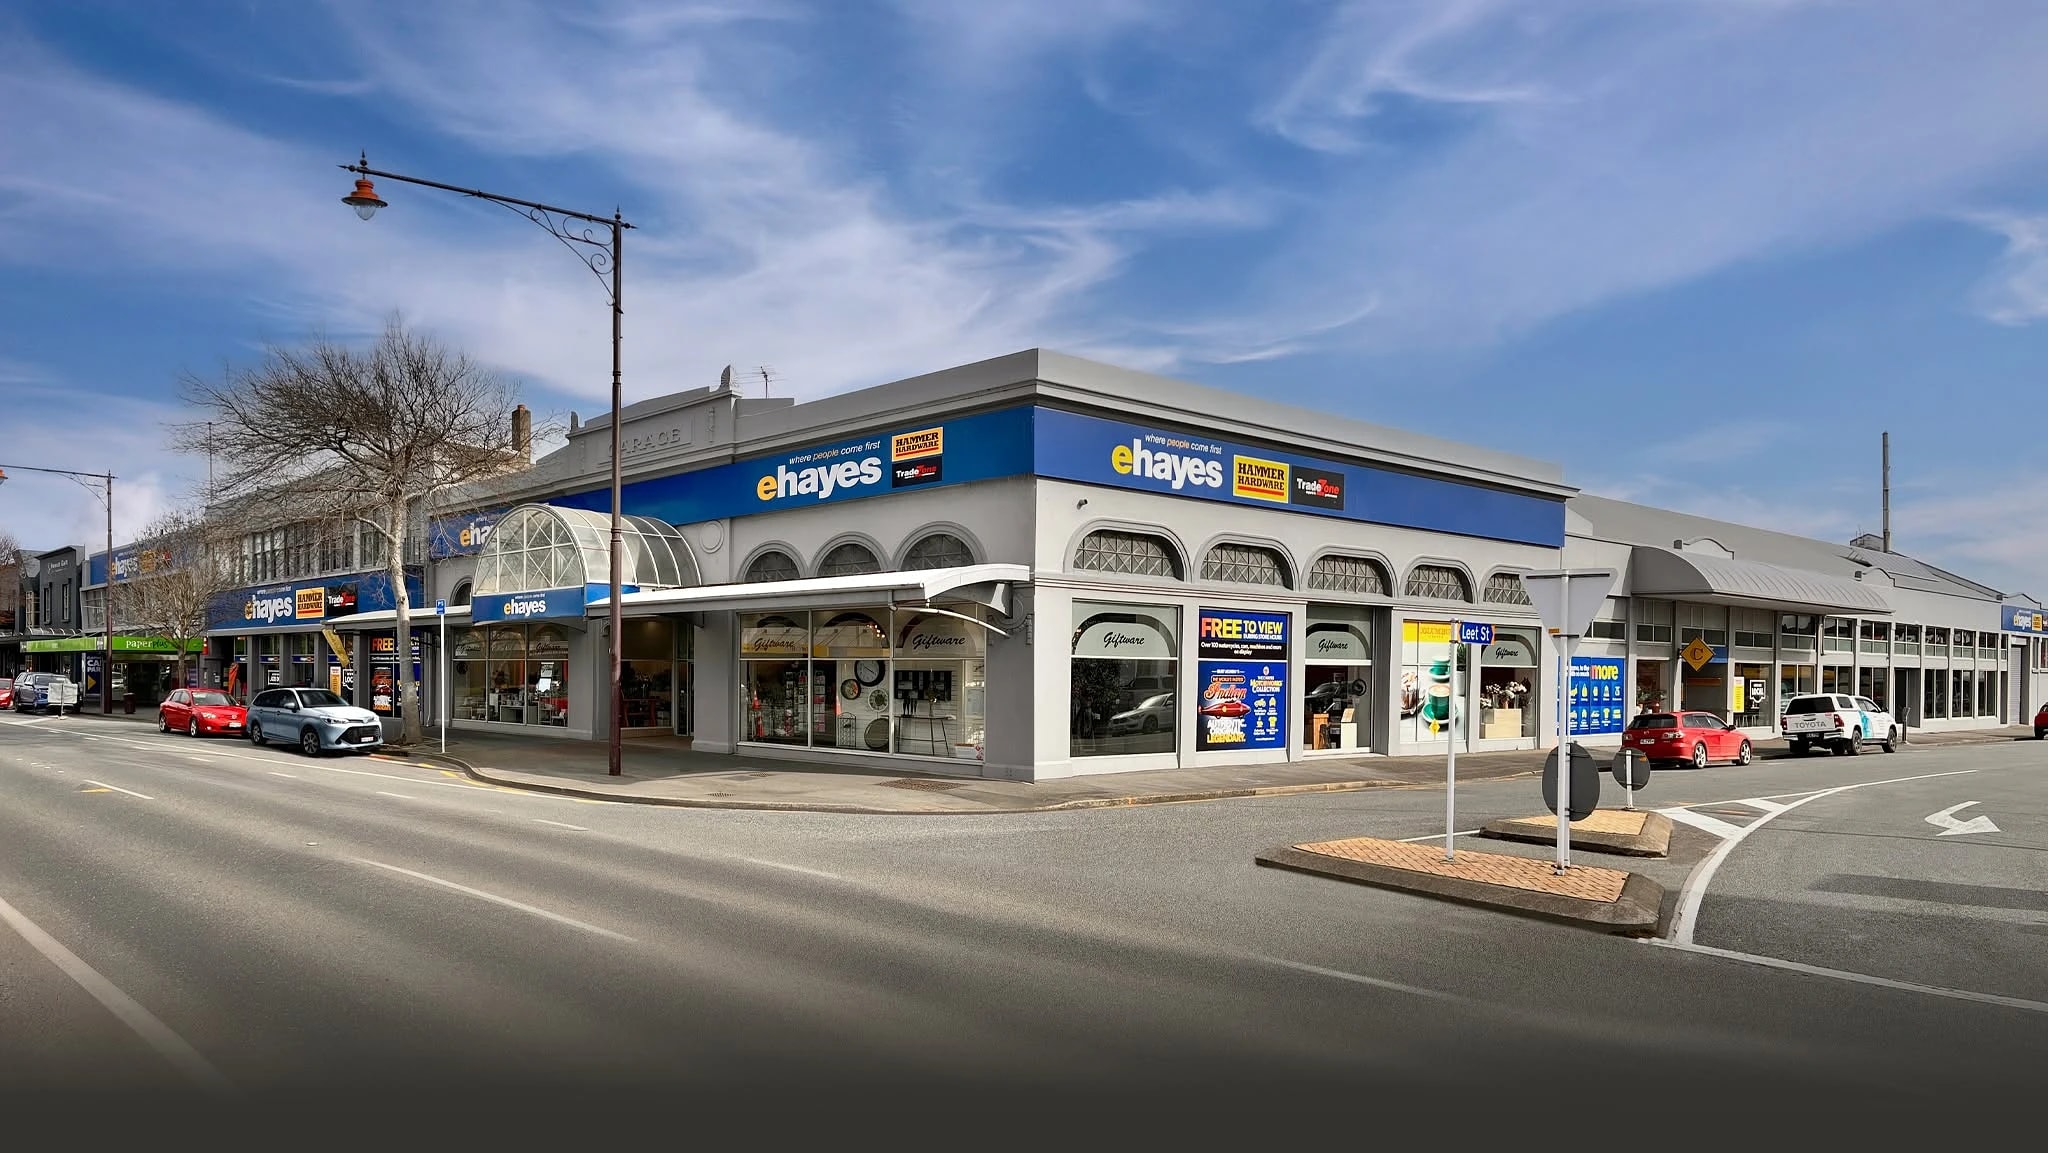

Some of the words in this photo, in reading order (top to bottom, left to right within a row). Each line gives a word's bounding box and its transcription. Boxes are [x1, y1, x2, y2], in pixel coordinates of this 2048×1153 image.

[896, 432, 939, 447] HAMMER
[896, 440, 939, 453] HARDWARE
[1145, 433, 1166, 445] where
[1167, 438, 1190, 449] people
[1191, 442, 1208, 452] come
[1209, 445, 1222, 455] first
[789, 454, 811, 465] where
[812, 449, 839, 461] people
[841, 445, 863, 455] come
[865, 440, 881, 451] first
[1111, 438, 1223, 490] ehayes
[1238, 462, 1285, 481] HAMMER
[756, 457, 882, 501] ehayes
[1238, 475, 1285, 490] HARDWARE
[297, 593, 323, 603] HAMMER
[244, 595, 293, 623] ehayes
[503, 598, 547, 617] ehayes
[1201, 617, 1242, 639] FREE
[1243, 620, 1257, 633] TO
[1258, 621, 1283, 634] VIEW
[1461, 624, 1479, 640] Leet
[1480, 625, 1490, 641] St
[372, 638, 394, 651] FREE
[754, 638, 795, 651] Giftware
[912, 633, 966, 650] Giftware
[1103, 632, 1145, 648] Giftware
[1318, 639, 1349, 653] Giftware
[1495, 647, 1519, 659] Giftware
[1591, 665, 1619, 680] more
[1204, 682, 1247, 700] Indian
